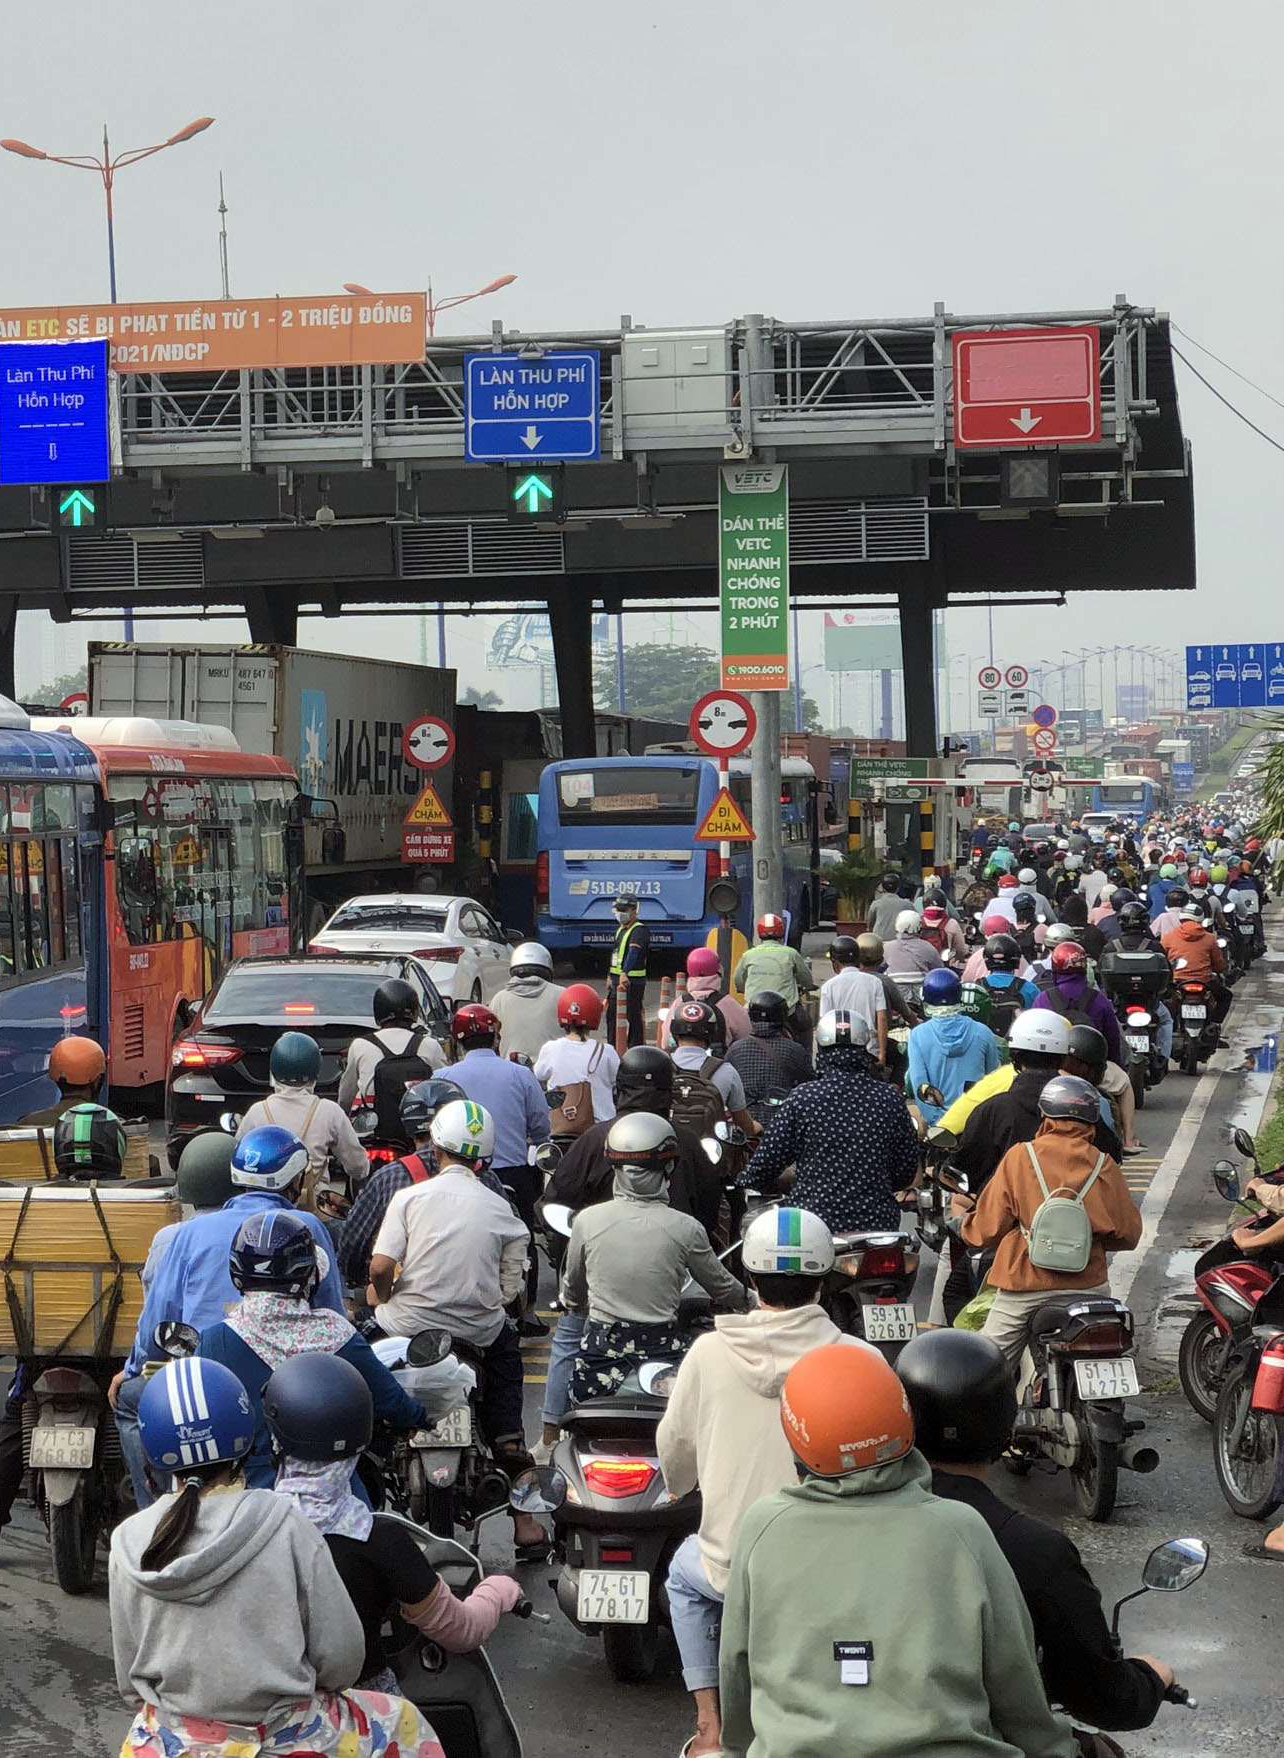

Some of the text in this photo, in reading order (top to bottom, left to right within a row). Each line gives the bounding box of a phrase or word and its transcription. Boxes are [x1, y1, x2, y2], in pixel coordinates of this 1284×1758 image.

[27, 319, 60, 337] ETC
[66, 314, 90, 335] SẼ
[96, 316, 114, 337] BỊ
[120, 314, 168, 336] PHẠT
[174, 307, 216, 331] TIỀN
[222, 308, 247, 329] TỪ
[251, 311, 260, 328] 1
[281, 310, 293, 327] 2
[299, 304, 353, 329] TRIỆU
[359, 300, 413, 324] ĐỒNG
[6, 364, 95, 384] Làn Thu Phí
[479, 363, 586, 385] LÀN THU PHÍ
[18, 391, 85, 409] Hỗn Hợp
[494, 389, 570, 412] HỖN HỢP
[734, 472, 773, 484] VETC
[723, 513, 785, 531] DÁN THẺ
[735, 537, 772, 550] VETC
[727, 557, 781, 570] NHANH
[727, 573, 781, 590] CHÓNG
[729, 596, 779, 609] TRONG
[729, 612, 779, 629] 2 PHÚT
[208, 668, 229, 678] MRKU
[237, 669, 252, 679] 487
[738, 665, 785, 674] 1900.6010
[1011, 671, 1022, 682] 60
[984, 672, 995, 684] 80
[237, 682, 256, 691] 45G1
[718, 807, 730, 818] ĐI
[590, 880, 661, 896] 51B-097.13
[871, 1307, 908, 1322] 59-X1
[869, 1322, 914, 1339] 326.87
[1084, 1361, 1124, 1380] 51-T1
[1089, 1378, 1130, 1396] 4275
[42, 1431, 85, 1446] 71-C3
[591, 1574, 636, 1596] 74-G1
[583, 1597, 644, 1619] 178.17
